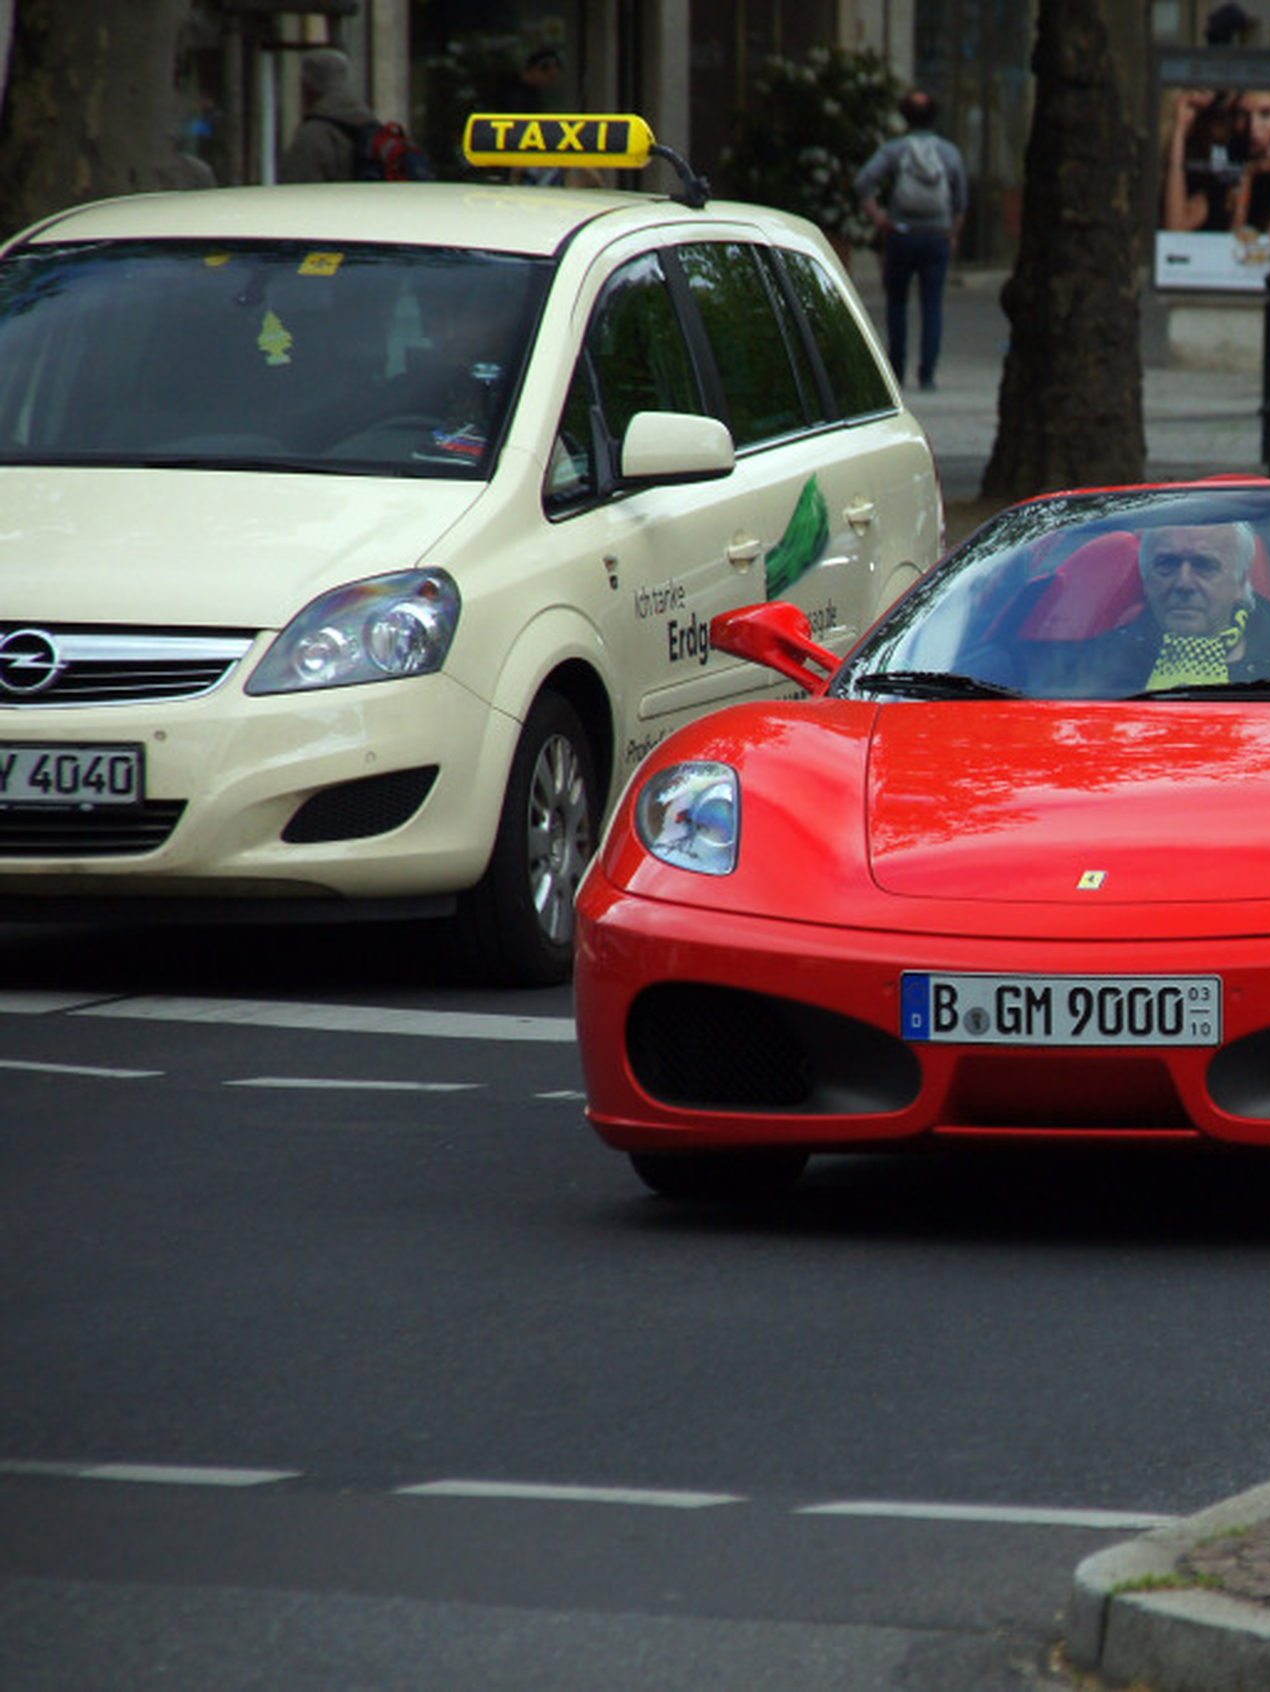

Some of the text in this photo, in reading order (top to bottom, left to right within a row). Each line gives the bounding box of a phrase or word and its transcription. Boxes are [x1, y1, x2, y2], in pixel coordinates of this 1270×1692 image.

[490, 120, 608, 151] TAXI
[667, 611, 714, 666] Erdg
[28, 753, 134, 795] 4040
[933, 983, 958, 1033] B
[995, 986, 1052, 1036] GM
[1067, 986, 1184, 1037] 9000
[1188, 987, 1211, 1001] 03
[1190, 1023, 1211, 1036] 10
